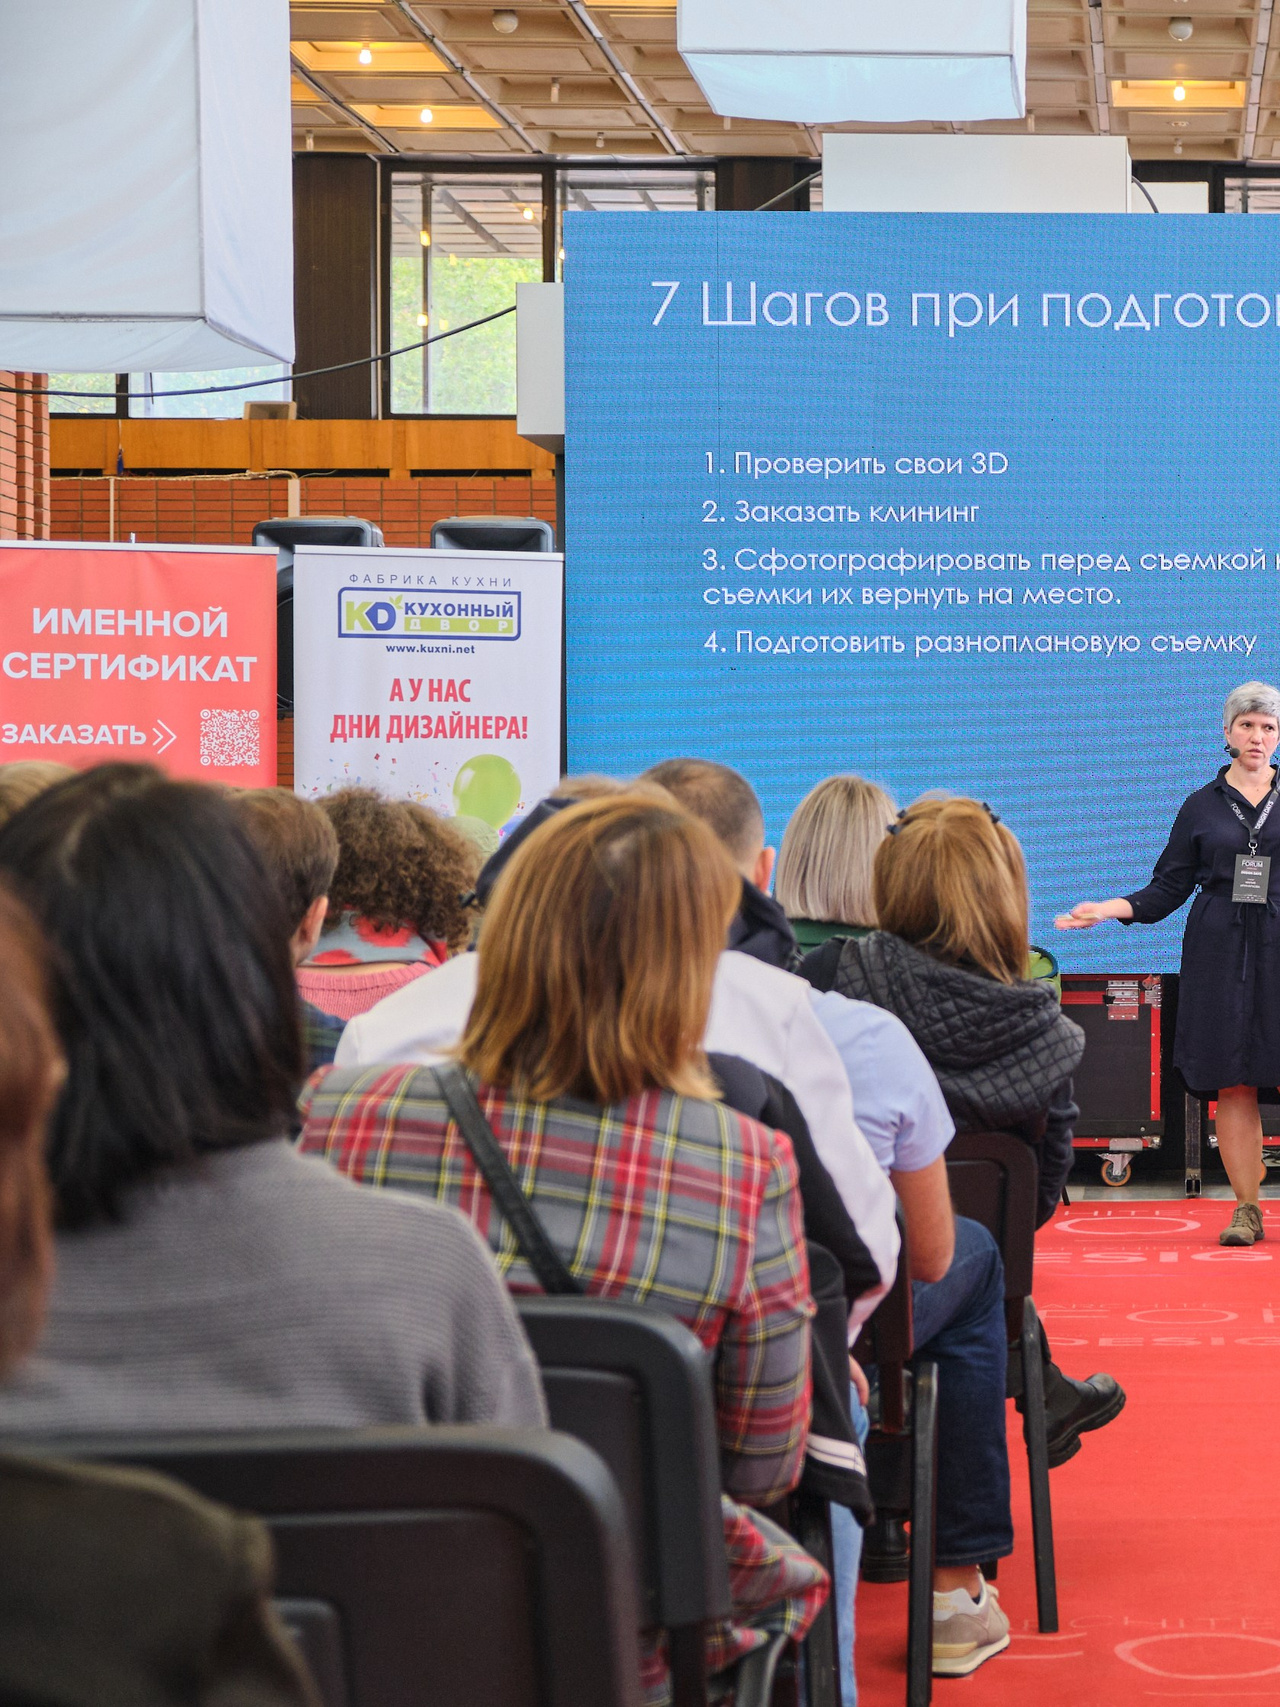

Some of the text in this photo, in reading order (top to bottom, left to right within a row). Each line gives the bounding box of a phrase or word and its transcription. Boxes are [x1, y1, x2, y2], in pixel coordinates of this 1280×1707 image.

[652, 281, 680, 326] 7
[702, 281, 889, 327] Шагов
[911, 292, 1019, 338] при
[704, 451, 1009, 479] 1. Проверить свои 3D
[702, 500, 980, 523] 2. Заказать клининг
[702, 548, 726, 571] 3.
[734, 547, 1031, 576] Сфотографировать
[1041, 553, 1132, 575] перед
[1140, 548, 1267, 571] съемкой
[349, 573, 512, 588] ФАБРИКА КУХНИ
[404, 601, 514, 618] КУХОННЫЙ
[702, 587, 1122, 609] съемки их вернуть на место.
[32, 605, 228, 638] ИМЕННОЙ
[409, 618, 509, 632] ДВОР
[385, 643, 476, 655] www.kuxni.net
[703, 630, 1257, 658] 4. Подготовить разноплановую съемку
[2, 651, 258, 682] СЕРТИФИКАТ
[389, 678, 472, 703] А У НАС
[1, 723, 147, 745] ЗАКАЗАТЬ
[329, 710, 528, 743] ДНИ ДИЗАЙНЕРА!
[1230, 802, 1245, 820] FORUM
[1241, 859, 1263, 868] FORUM
